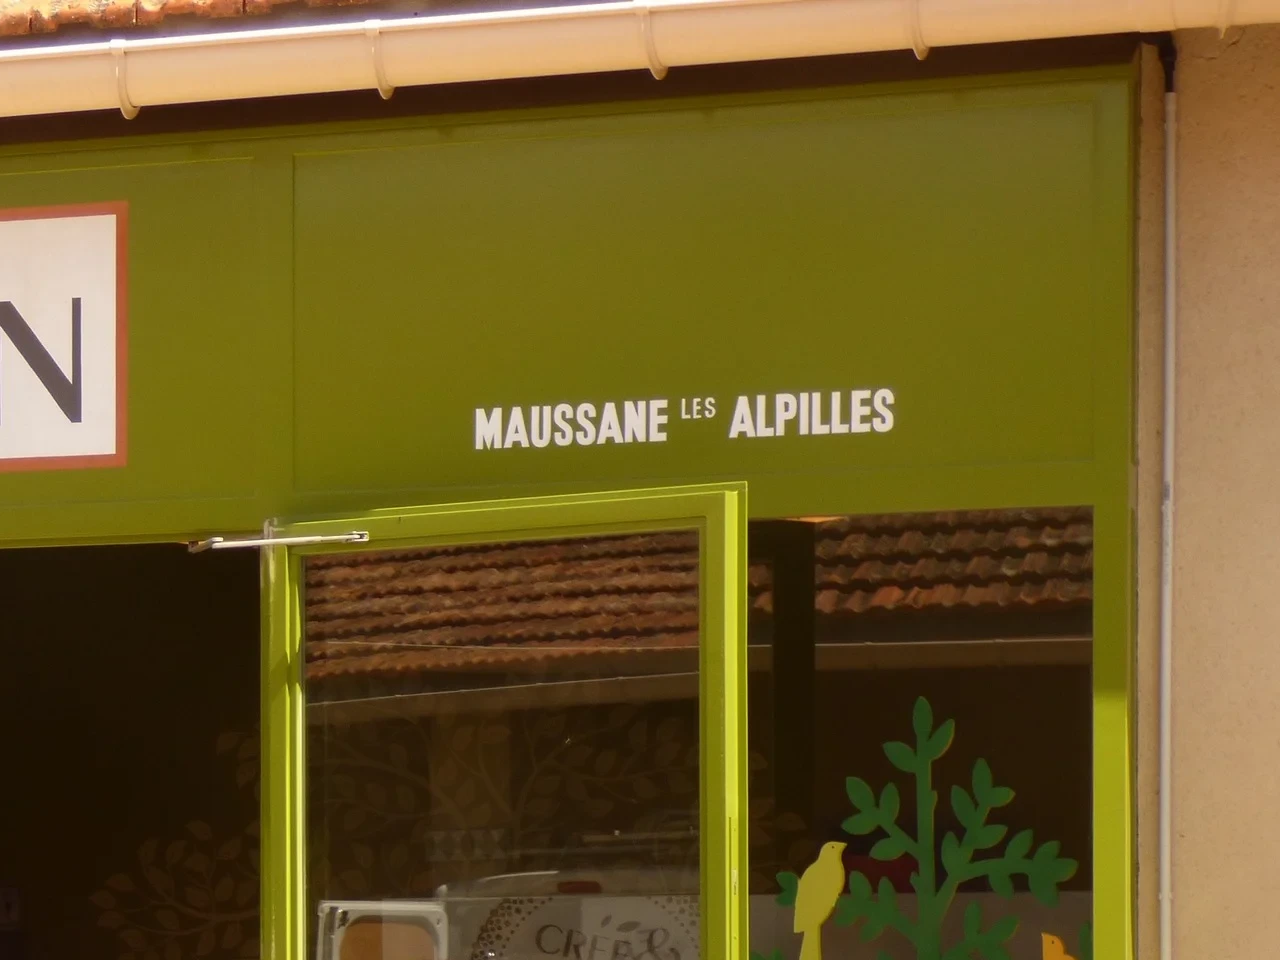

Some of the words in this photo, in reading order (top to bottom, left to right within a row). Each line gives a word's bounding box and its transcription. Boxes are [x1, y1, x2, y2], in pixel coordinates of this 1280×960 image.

[475, 399, 668, 450] MAUSSANE
[681, 397, 716, 419] LES
[729, 388, 895, 439] ALPILLES
